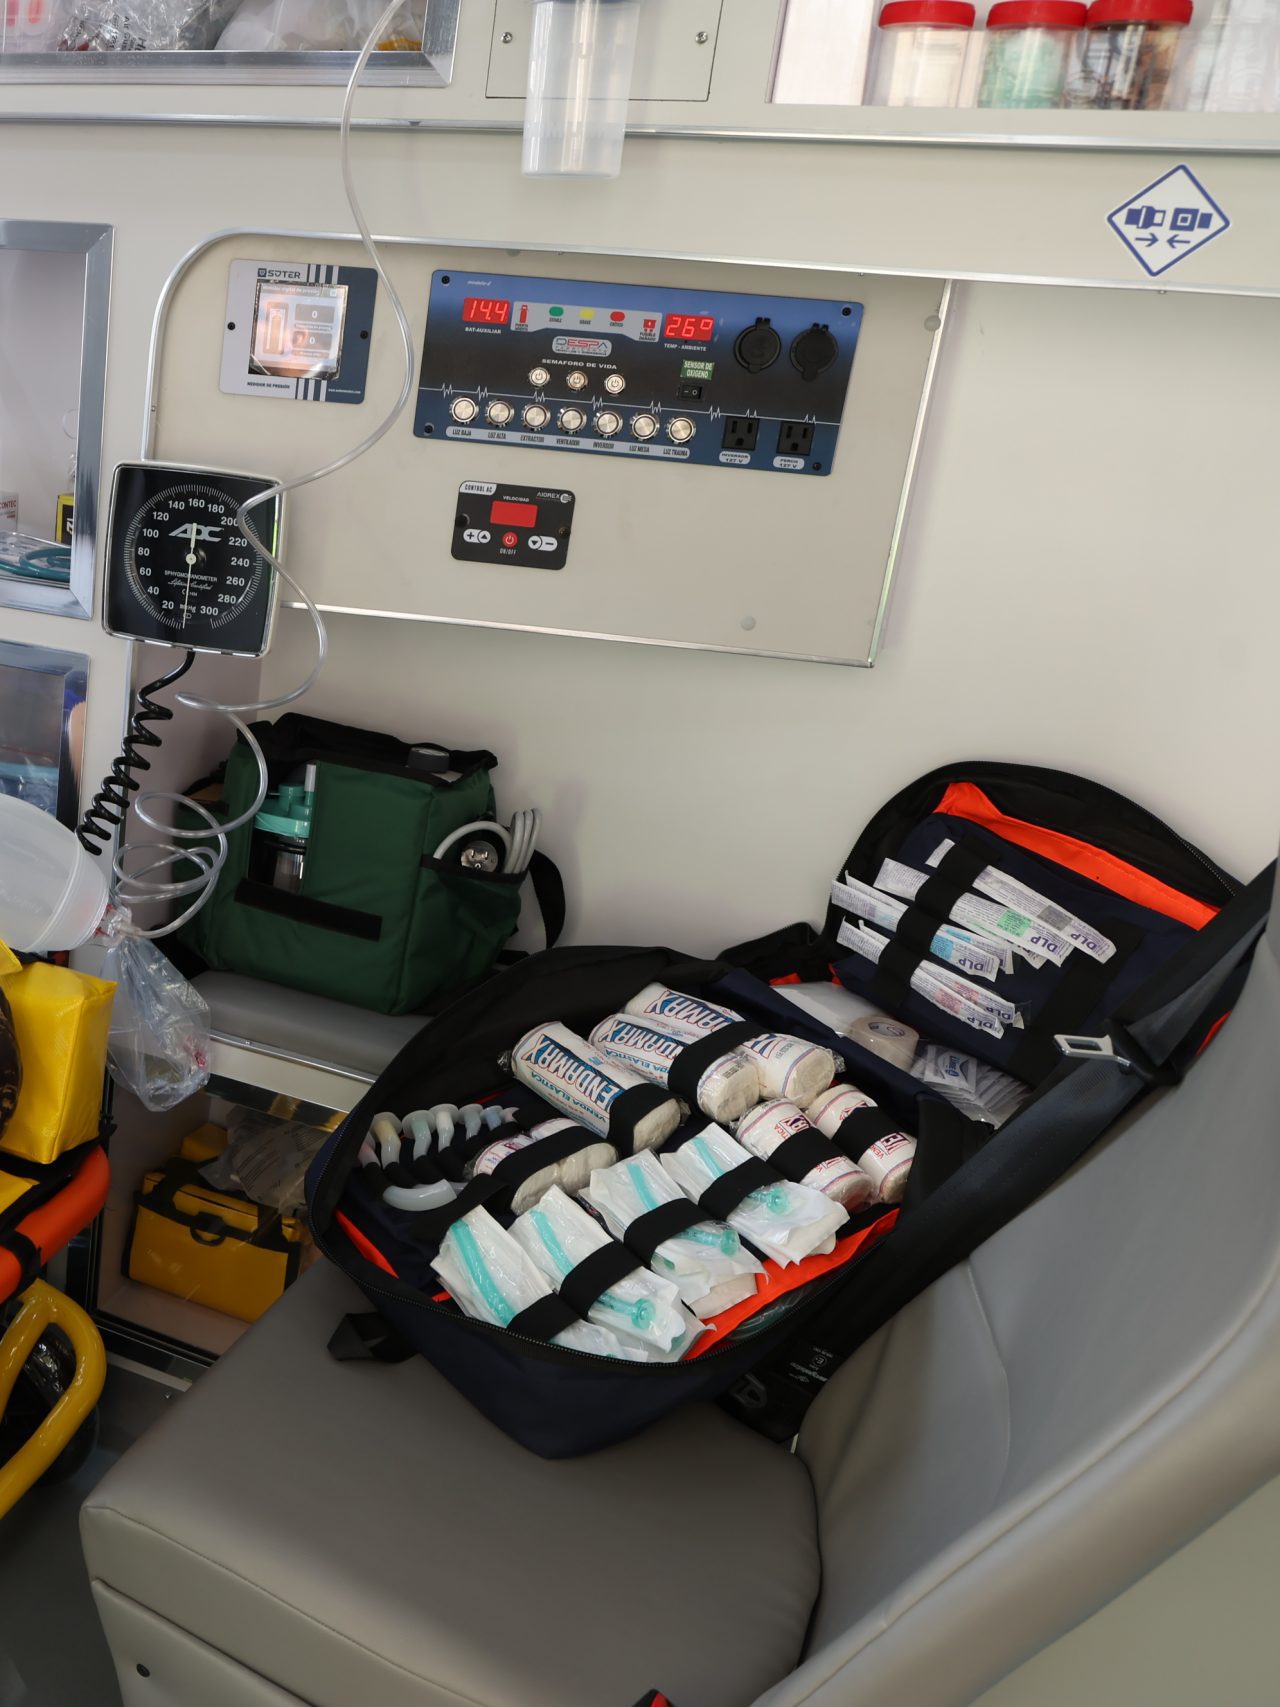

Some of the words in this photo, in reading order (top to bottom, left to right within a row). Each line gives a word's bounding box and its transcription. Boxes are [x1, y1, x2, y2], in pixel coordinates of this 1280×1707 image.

[311, 310, 318, 319] 0
[469, 300, 508, 321] 14.4
[309, 336, 316, 345] 0
[681, 344, 707, 352] AMBIENTE
[541, 358, 585, 367] SEMAFORO
[684, 361, 702, 370] SENSOR
[168, 500, 185, 511] 140
[188, 498, 205, 508] 160
[207, 503, 225, 514] 180
[152, 511, 169, 522] 120
[220, 516, 238, 527] 200
[142, 528, 159, 538] 100
[228, 537, 248, 547] 220
[137, 547, 150, 557] 80
[230, 556, 250, 567] 240
[139, 567, 152, 577] 60
[226, 576, 245, 587] 260
[147, 585, 160, 596] 40
[217, 593, 237, 605] 280
[162, 600, 175, 610] 20
[200, 605, 219, 616] 300
[1030, 934, 1059, 954] DLP
[1070, 931, 1098, 951] DLP
[958, 957, 985, 972] DLP
[985, 1006, 1011, 1020] DLP
[966, 1015, 993, 1030] DLP
[572, 1098, 607, 1123] VENDA
